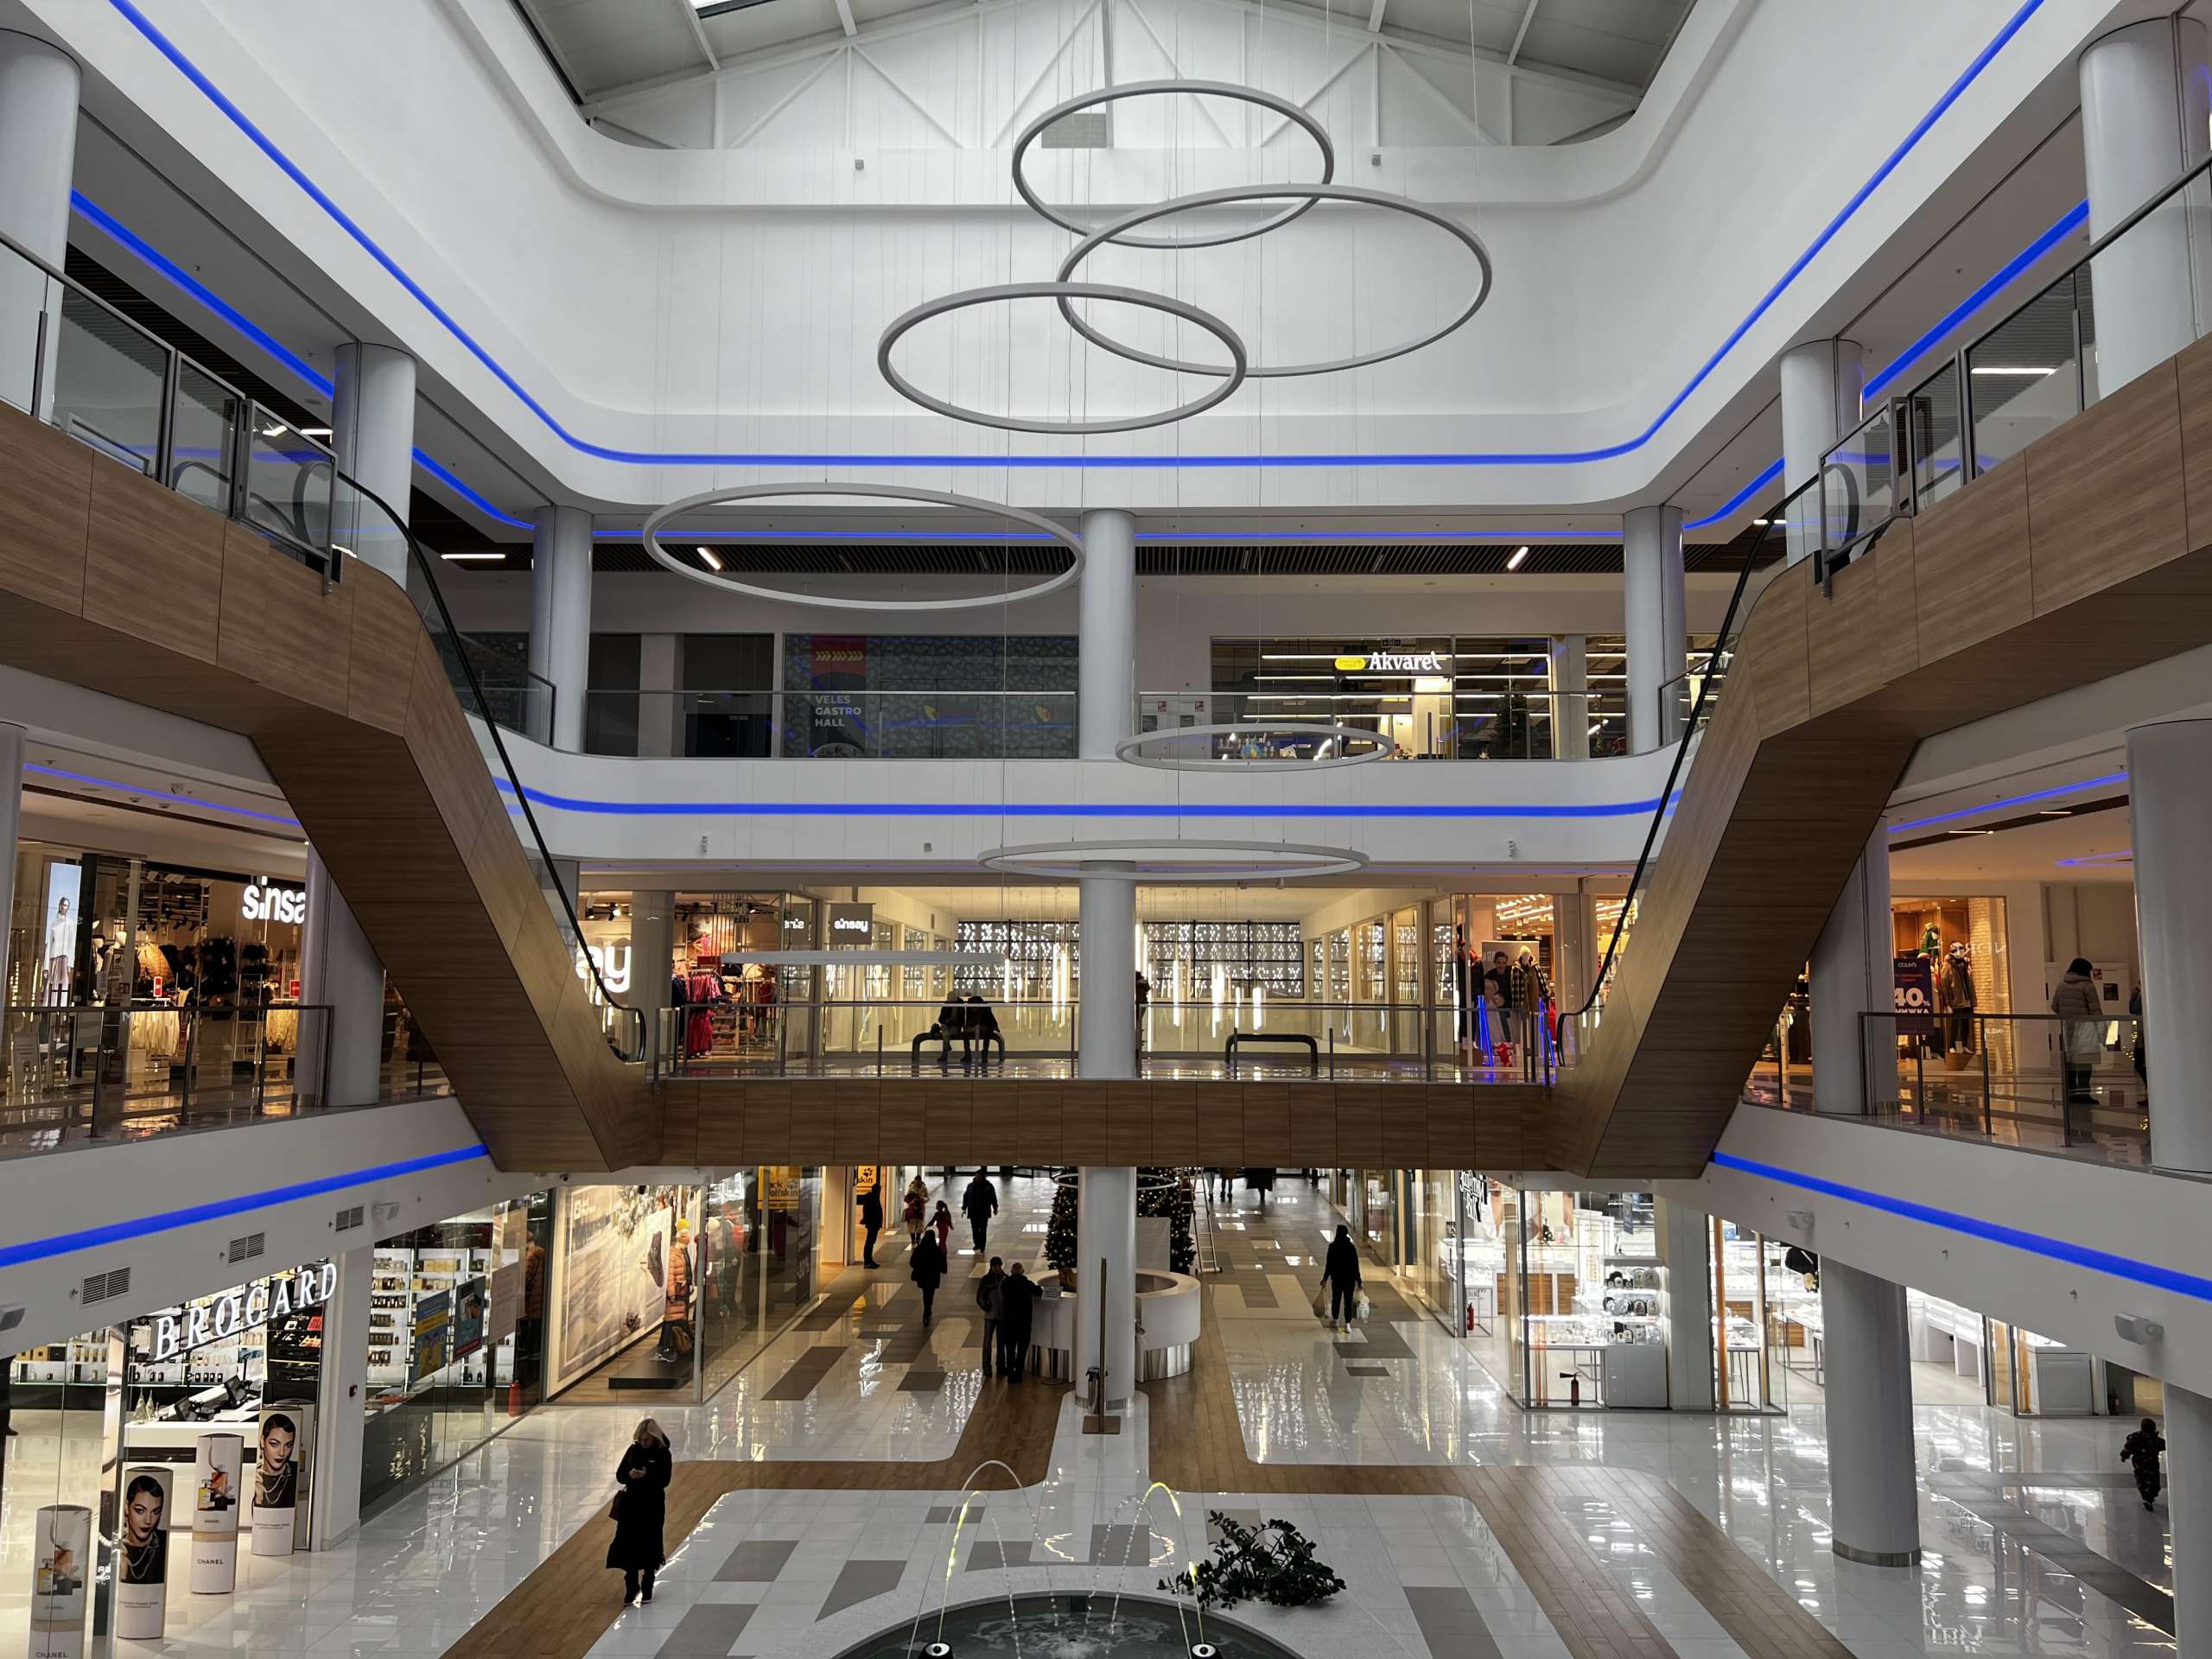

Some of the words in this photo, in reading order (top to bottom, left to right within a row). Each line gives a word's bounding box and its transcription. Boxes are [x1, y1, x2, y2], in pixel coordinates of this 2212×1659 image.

[1369, 651, 1441, 670] Akvarel
[815, 695, 851, 704] VELES
[815, 707, 862, 715] GASTRO
[815, 718, 845, 727] HALL
[242, 875, 306, 924] sinsa
[834, 918, 868, 932] sinsay
[768, 1188, 798, 1197] olfskin
[154, 1263, 337, 1362] BROCARD
